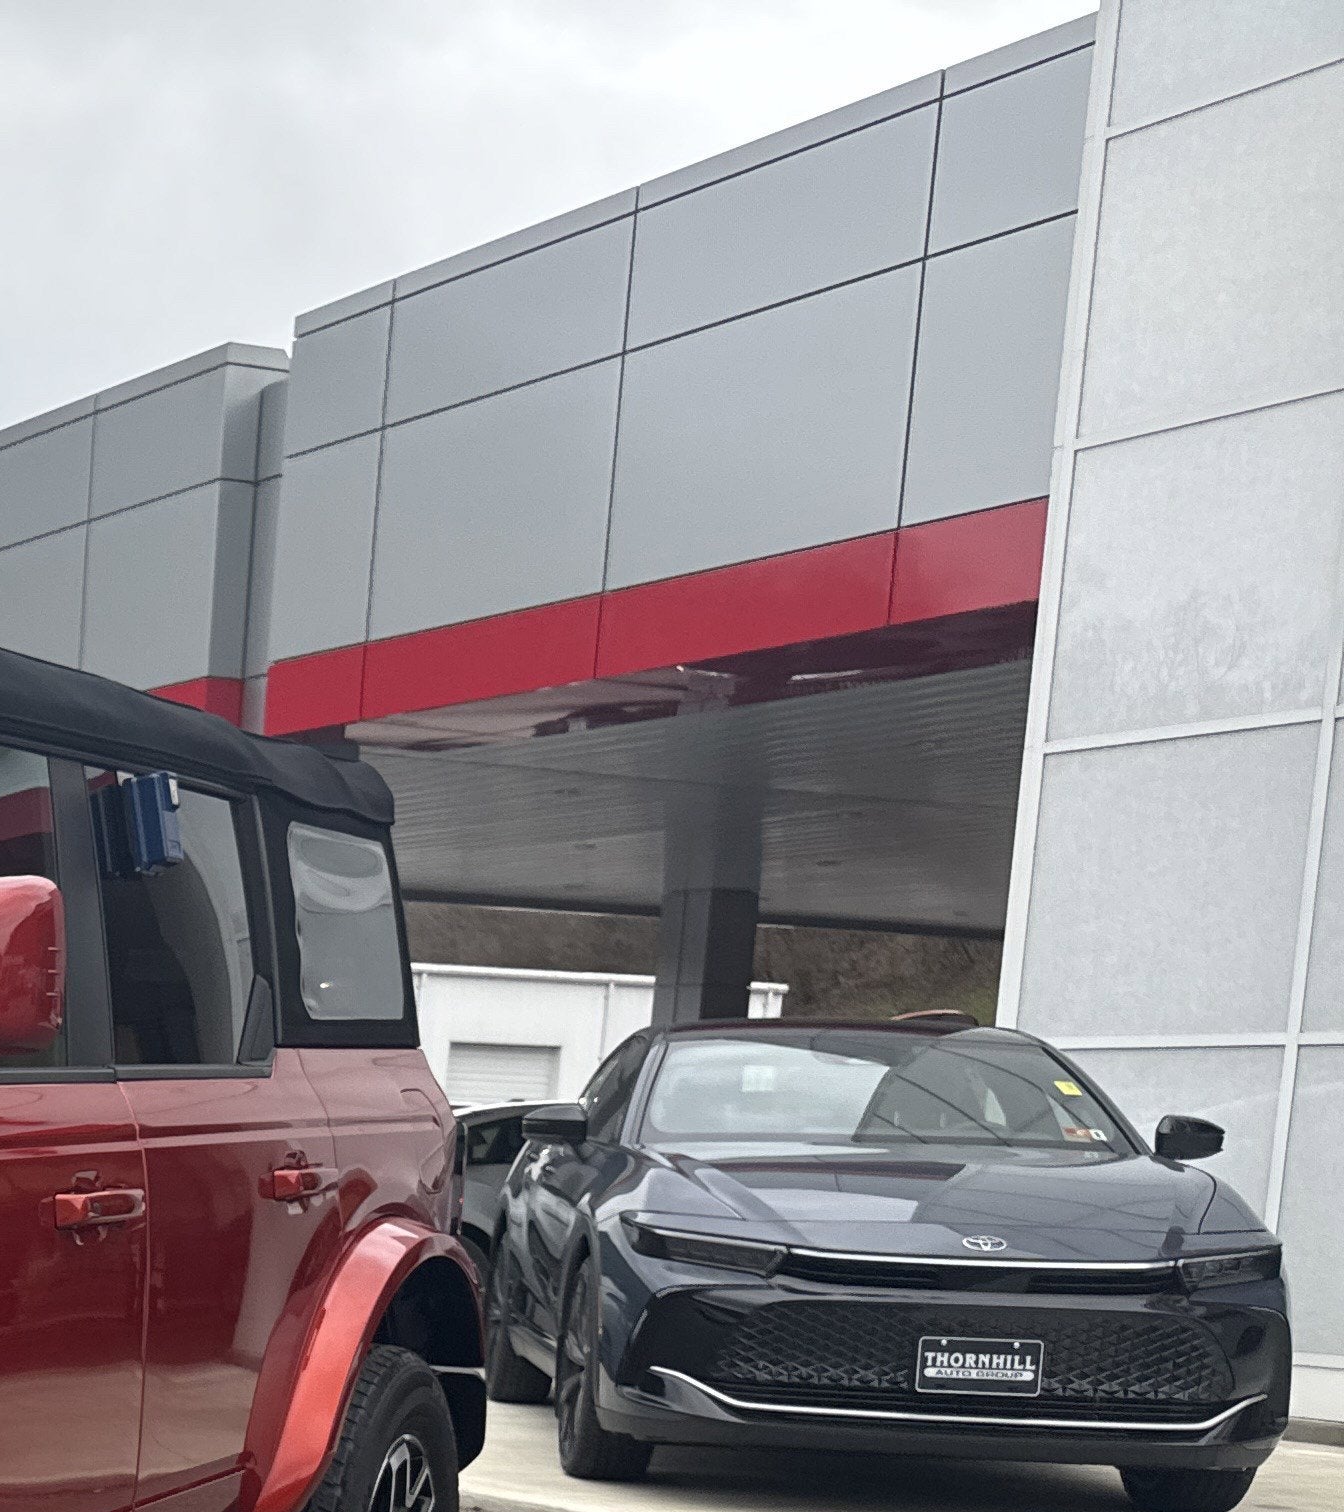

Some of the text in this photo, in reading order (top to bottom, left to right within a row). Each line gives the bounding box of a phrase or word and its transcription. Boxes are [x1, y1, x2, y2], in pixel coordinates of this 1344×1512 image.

[924, 1351, 1036, 1370] THORNHILL
[935, 1369, 1024, 1379] AUTO GROUP
